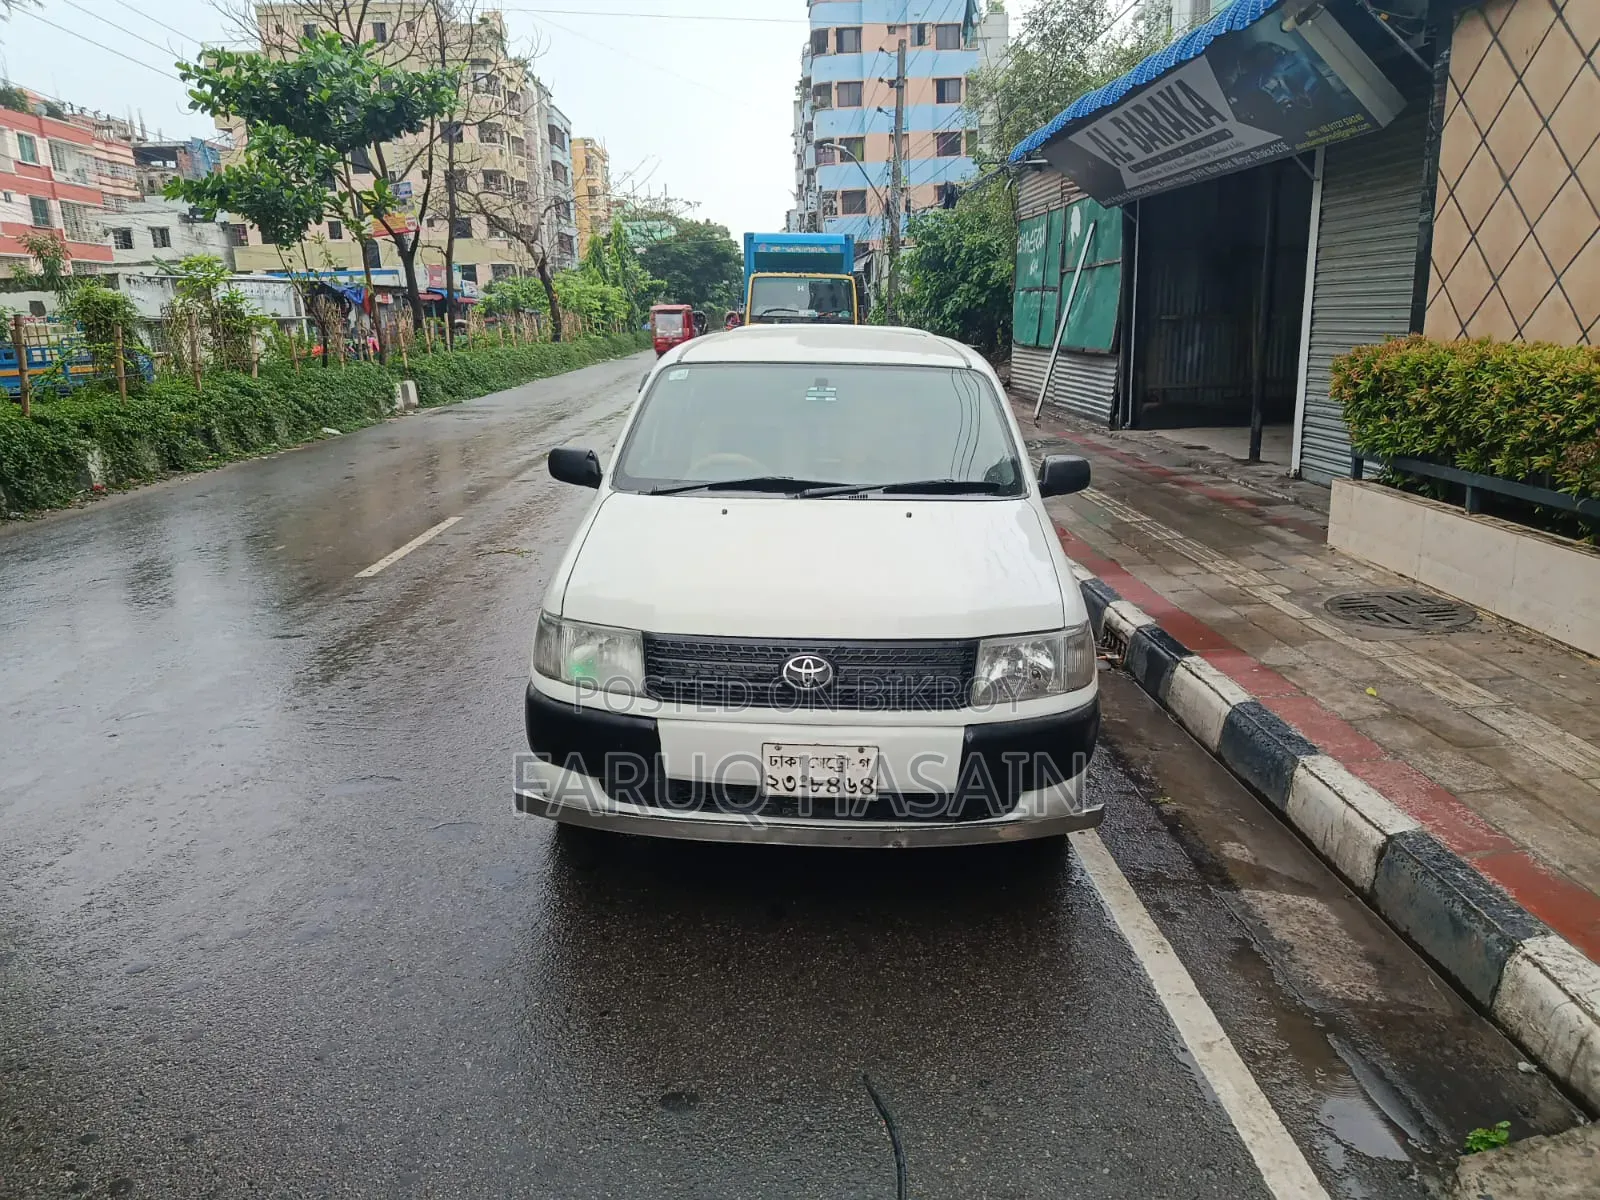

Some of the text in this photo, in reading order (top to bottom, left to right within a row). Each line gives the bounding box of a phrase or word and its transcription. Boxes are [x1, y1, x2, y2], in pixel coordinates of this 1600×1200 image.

[1086, 79, 1228, 166] AL-BARAKA
[768, 755, 804, 769] ঢাকা
[766, 774, 874, 795] ২৩-৮৪৬৪
